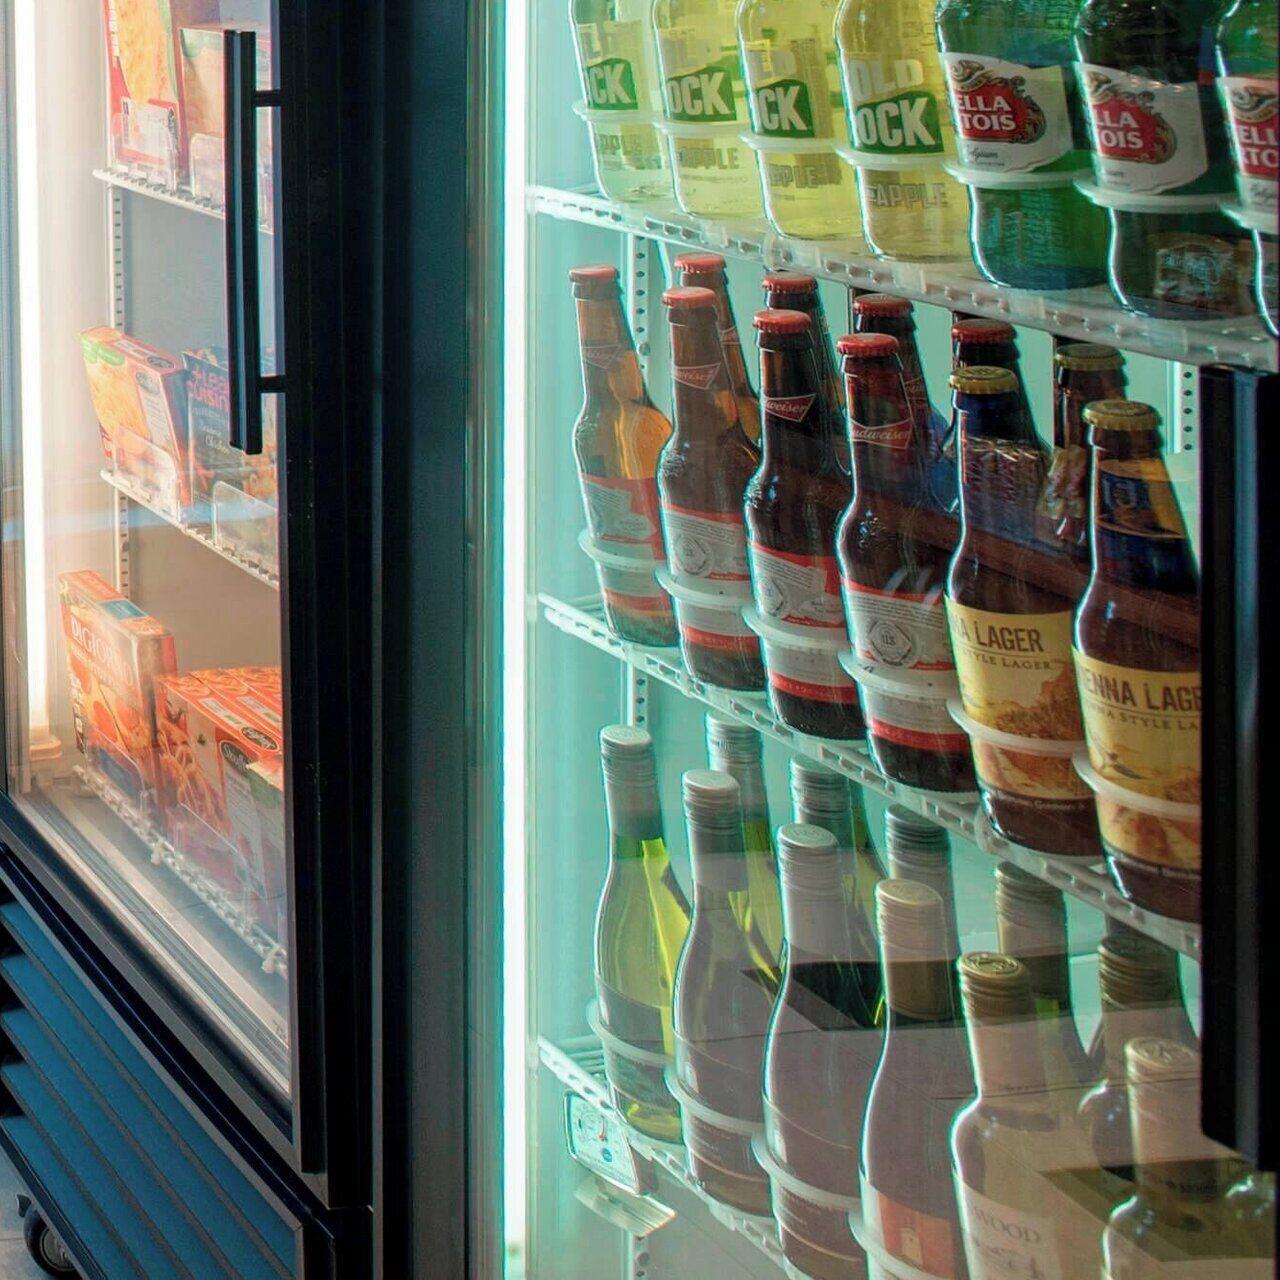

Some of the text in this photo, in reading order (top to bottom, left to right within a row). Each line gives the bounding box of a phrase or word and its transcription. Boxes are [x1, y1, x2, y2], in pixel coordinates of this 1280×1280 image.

[847, 58, 925, 100] OLD
[668, 72, 730, 115] OCK
[958, 94, 1012, 113] ELLA
[857, 97, 936, 148] OCK
[961, 114, 1018, 132] TOIS
[1095, 109, 1139, 129] LLA
[1100, 132, 1145, 150] OIS
[1240, 126, 1280, 146] ELL
[764, 400, 809, 417] weiser
[850, 427, 912, 444] udweiser
[975, 619, 1045, 653] LAGER
[1001, 656, 1052, 671] LAGER
[1088, 668, 1202, 713] ENNA LAGE
